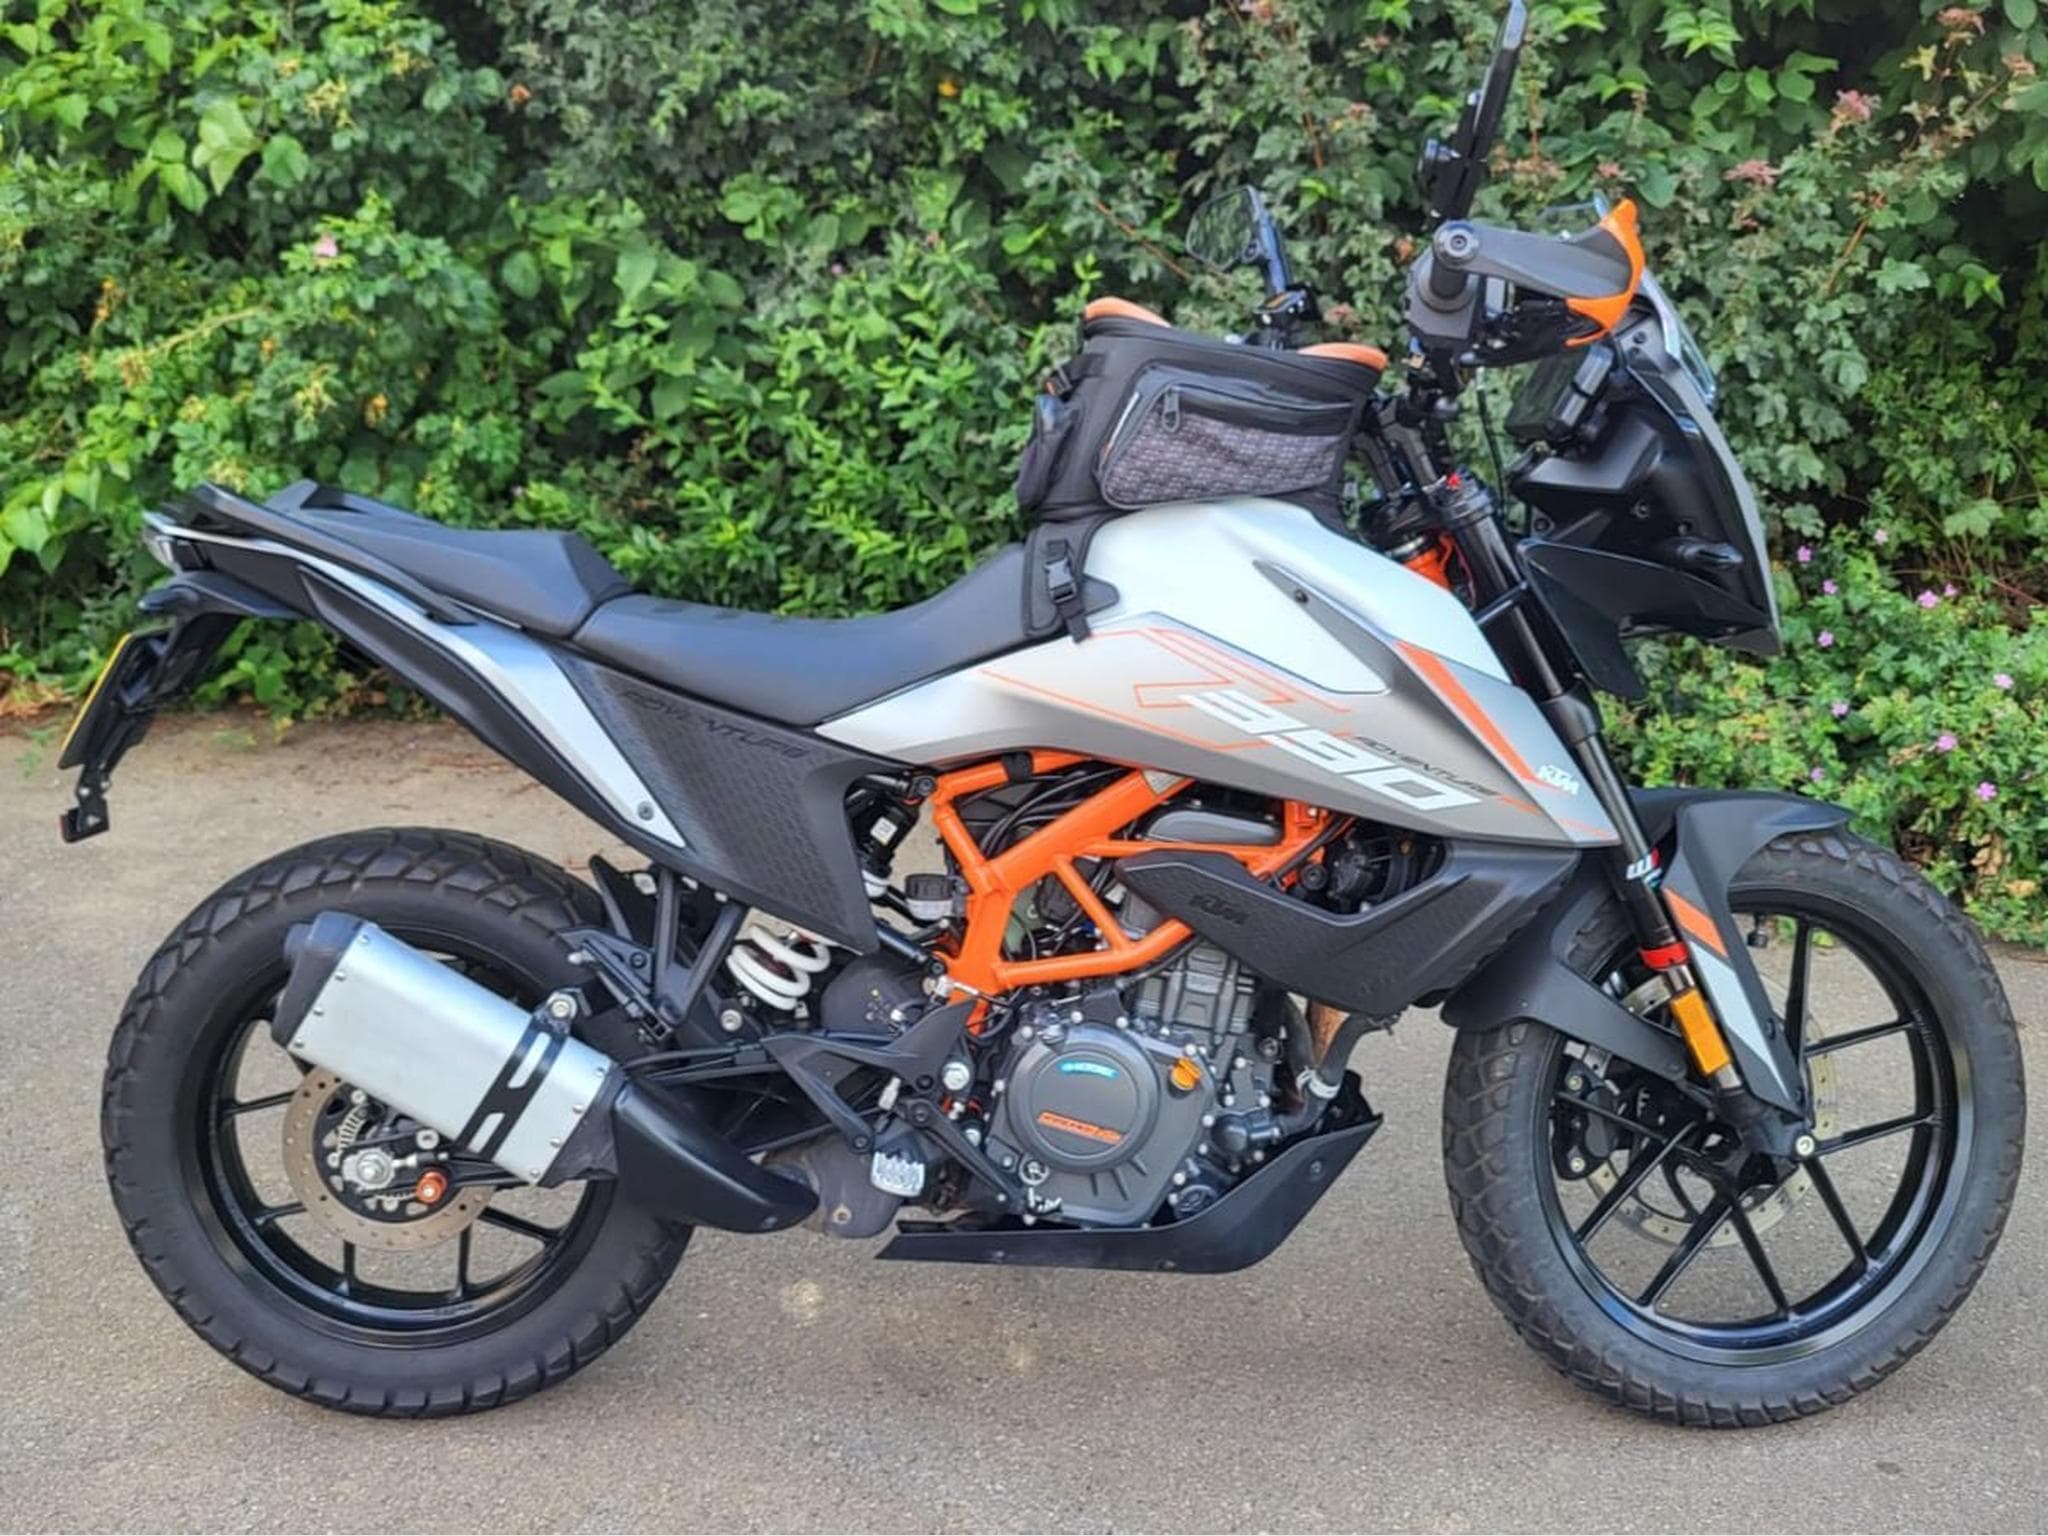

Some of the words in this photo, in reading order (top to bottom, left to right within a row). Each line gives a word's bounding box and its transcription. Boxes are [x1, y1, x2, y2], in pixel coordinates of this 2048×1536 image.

[616, 690, 812, 758] ADVNTURE
[1177, 689, 1482, 811] 390
[1538, 765, 1579, 795] KTM
